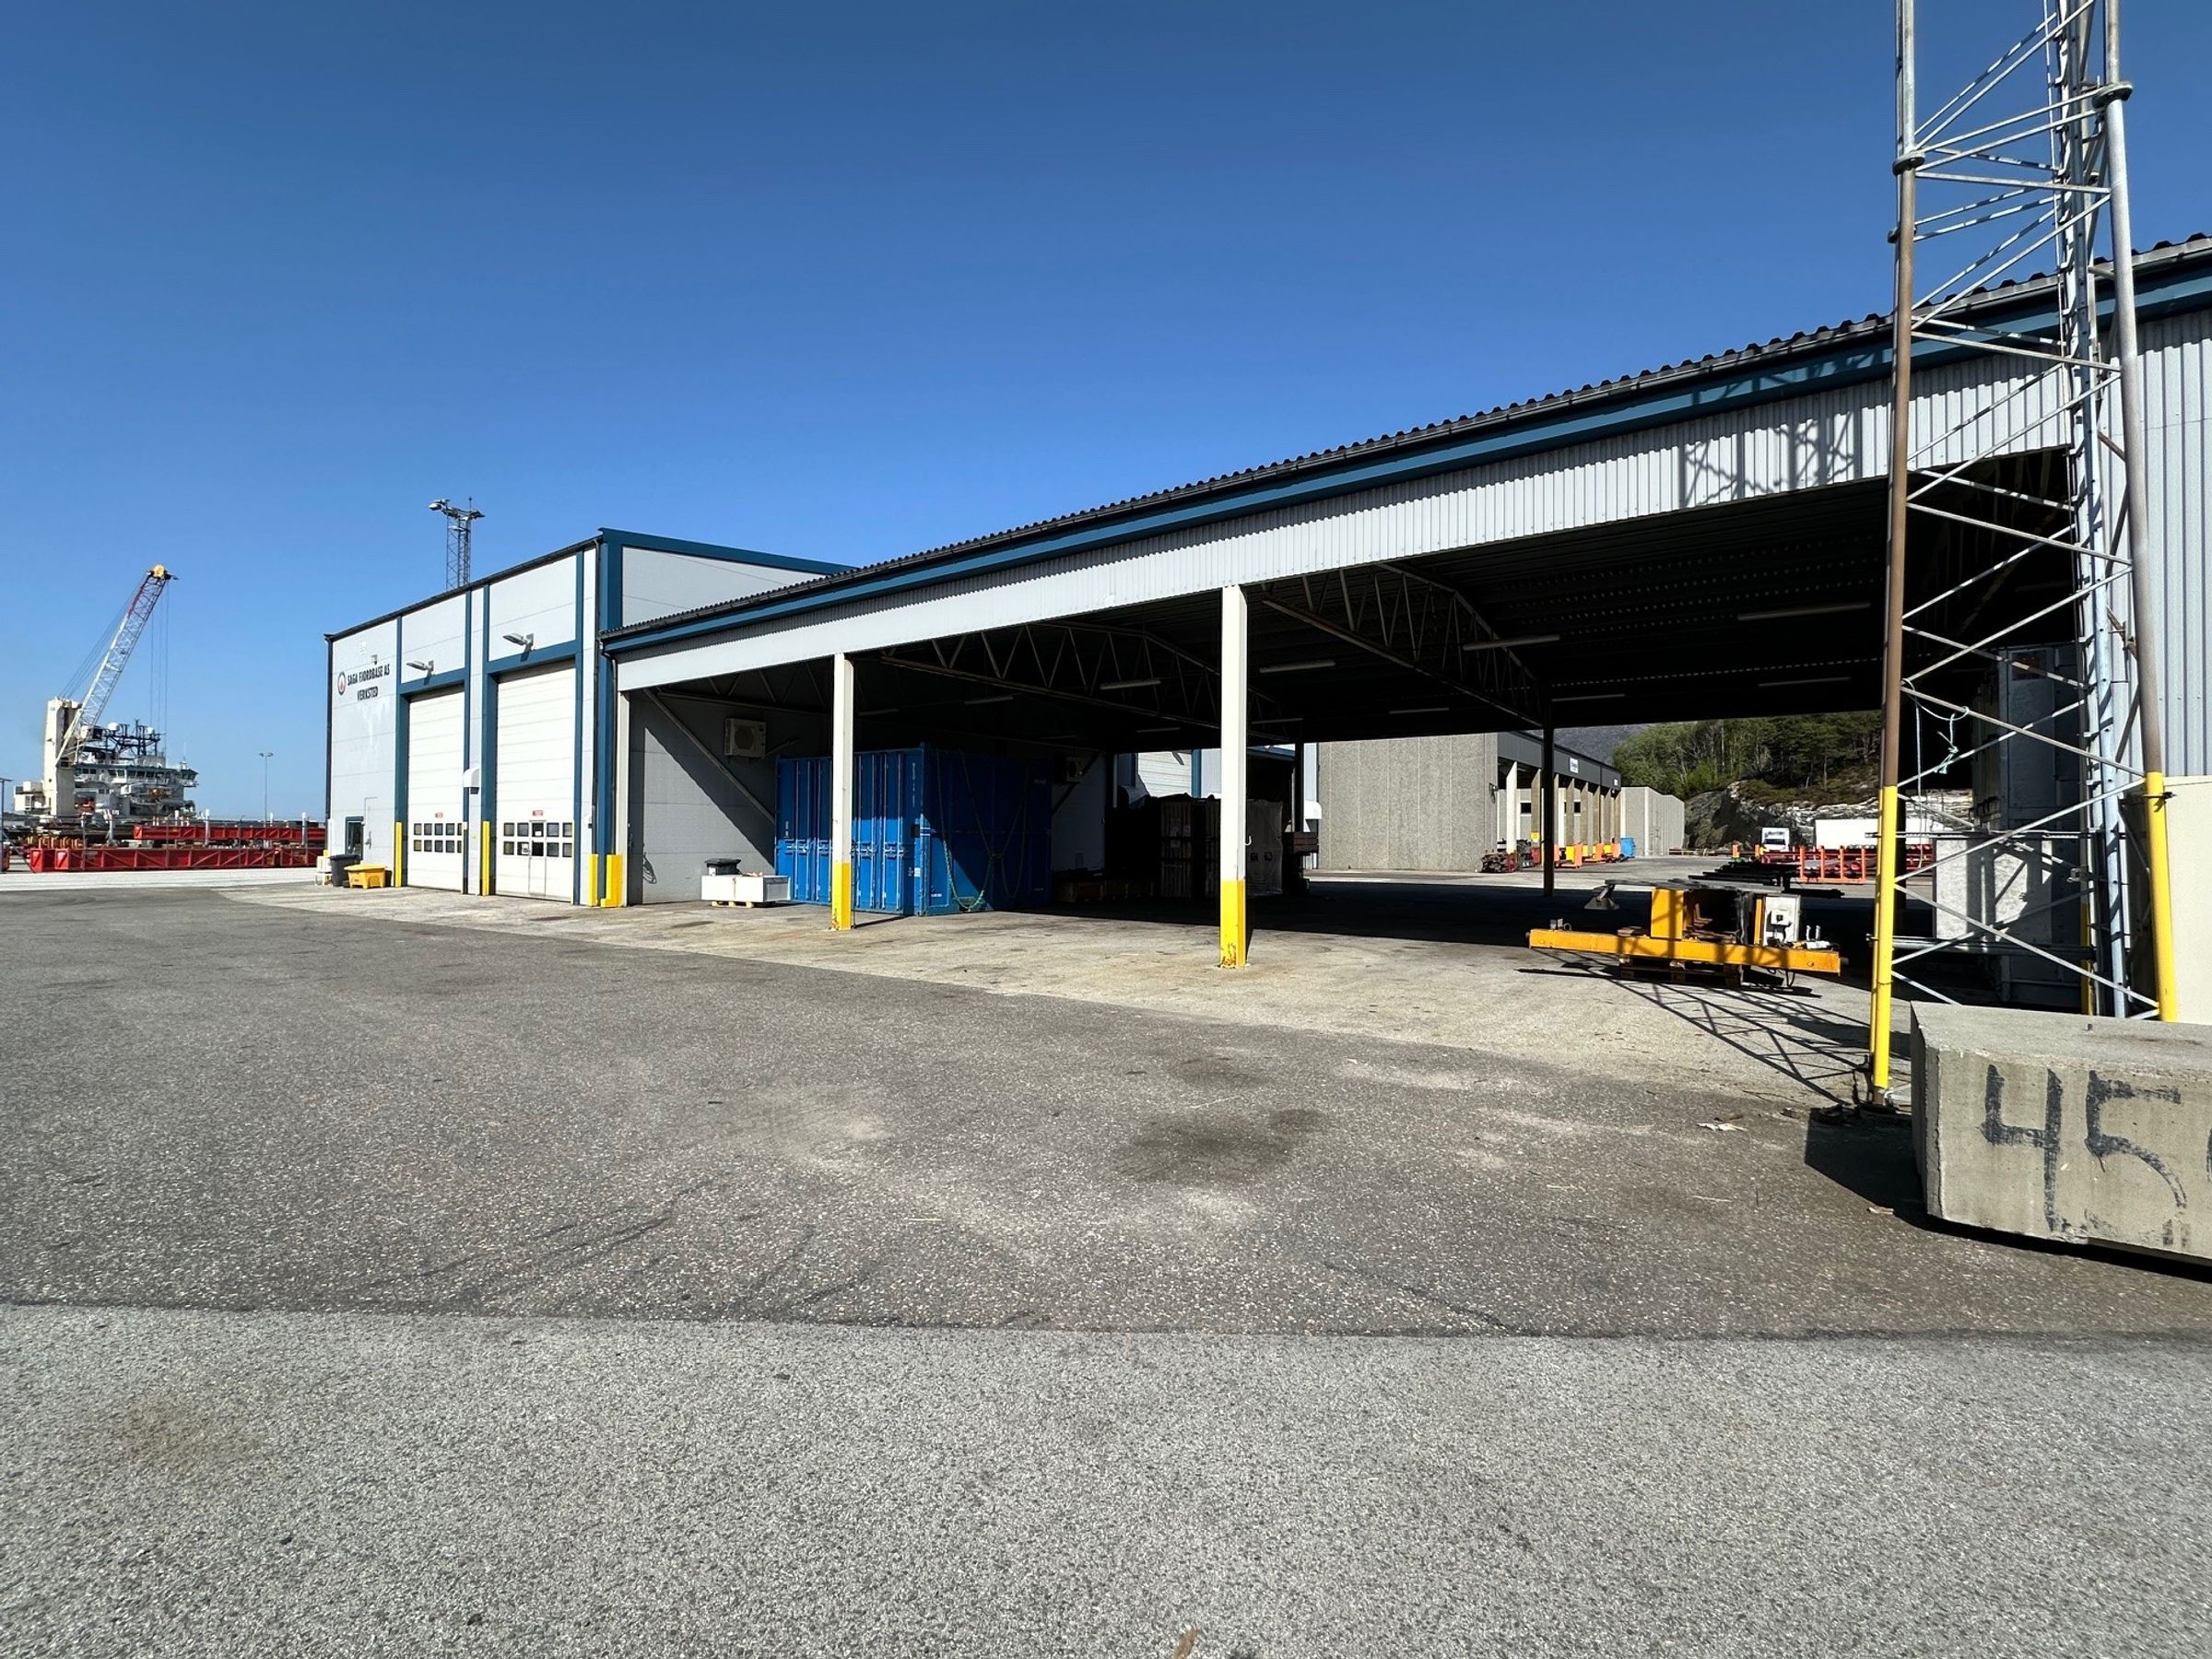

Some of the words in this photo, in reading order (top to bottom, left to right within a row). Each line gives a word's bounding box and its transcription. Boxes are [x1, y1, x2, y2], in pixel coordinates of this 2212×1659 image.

[347, 673, 358, 686] SAGA
[383, 663, 391, 676] AS
[357, 686, 379, 700] VERKSTED
[1980, 1064, 2212, 1245] 45
